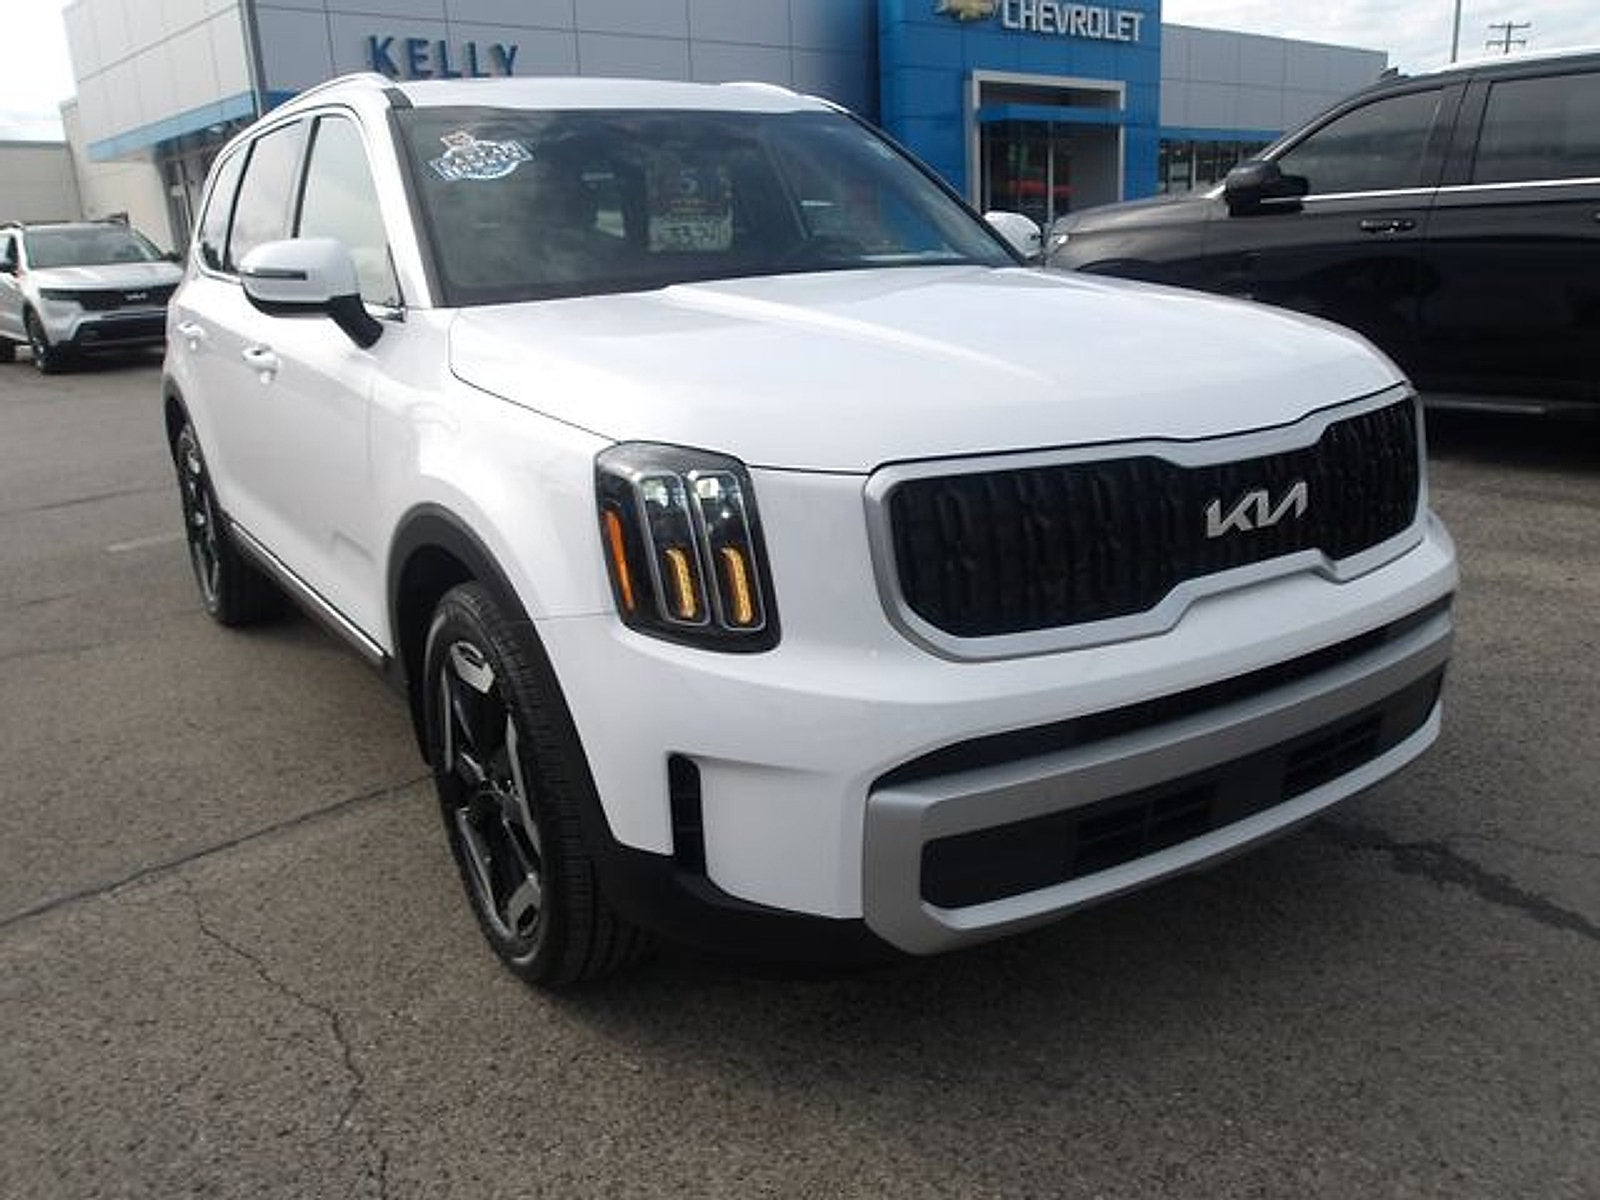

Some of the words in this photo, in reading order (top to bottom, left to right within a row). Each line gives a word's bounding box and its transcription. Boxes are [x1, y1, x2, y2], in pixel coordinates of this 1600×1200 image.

[1003, 0, 1143, 41] CHEVROLET
[368, 35, 518, 79] KELLY
[1207, 481, 1308, 538] KIA
